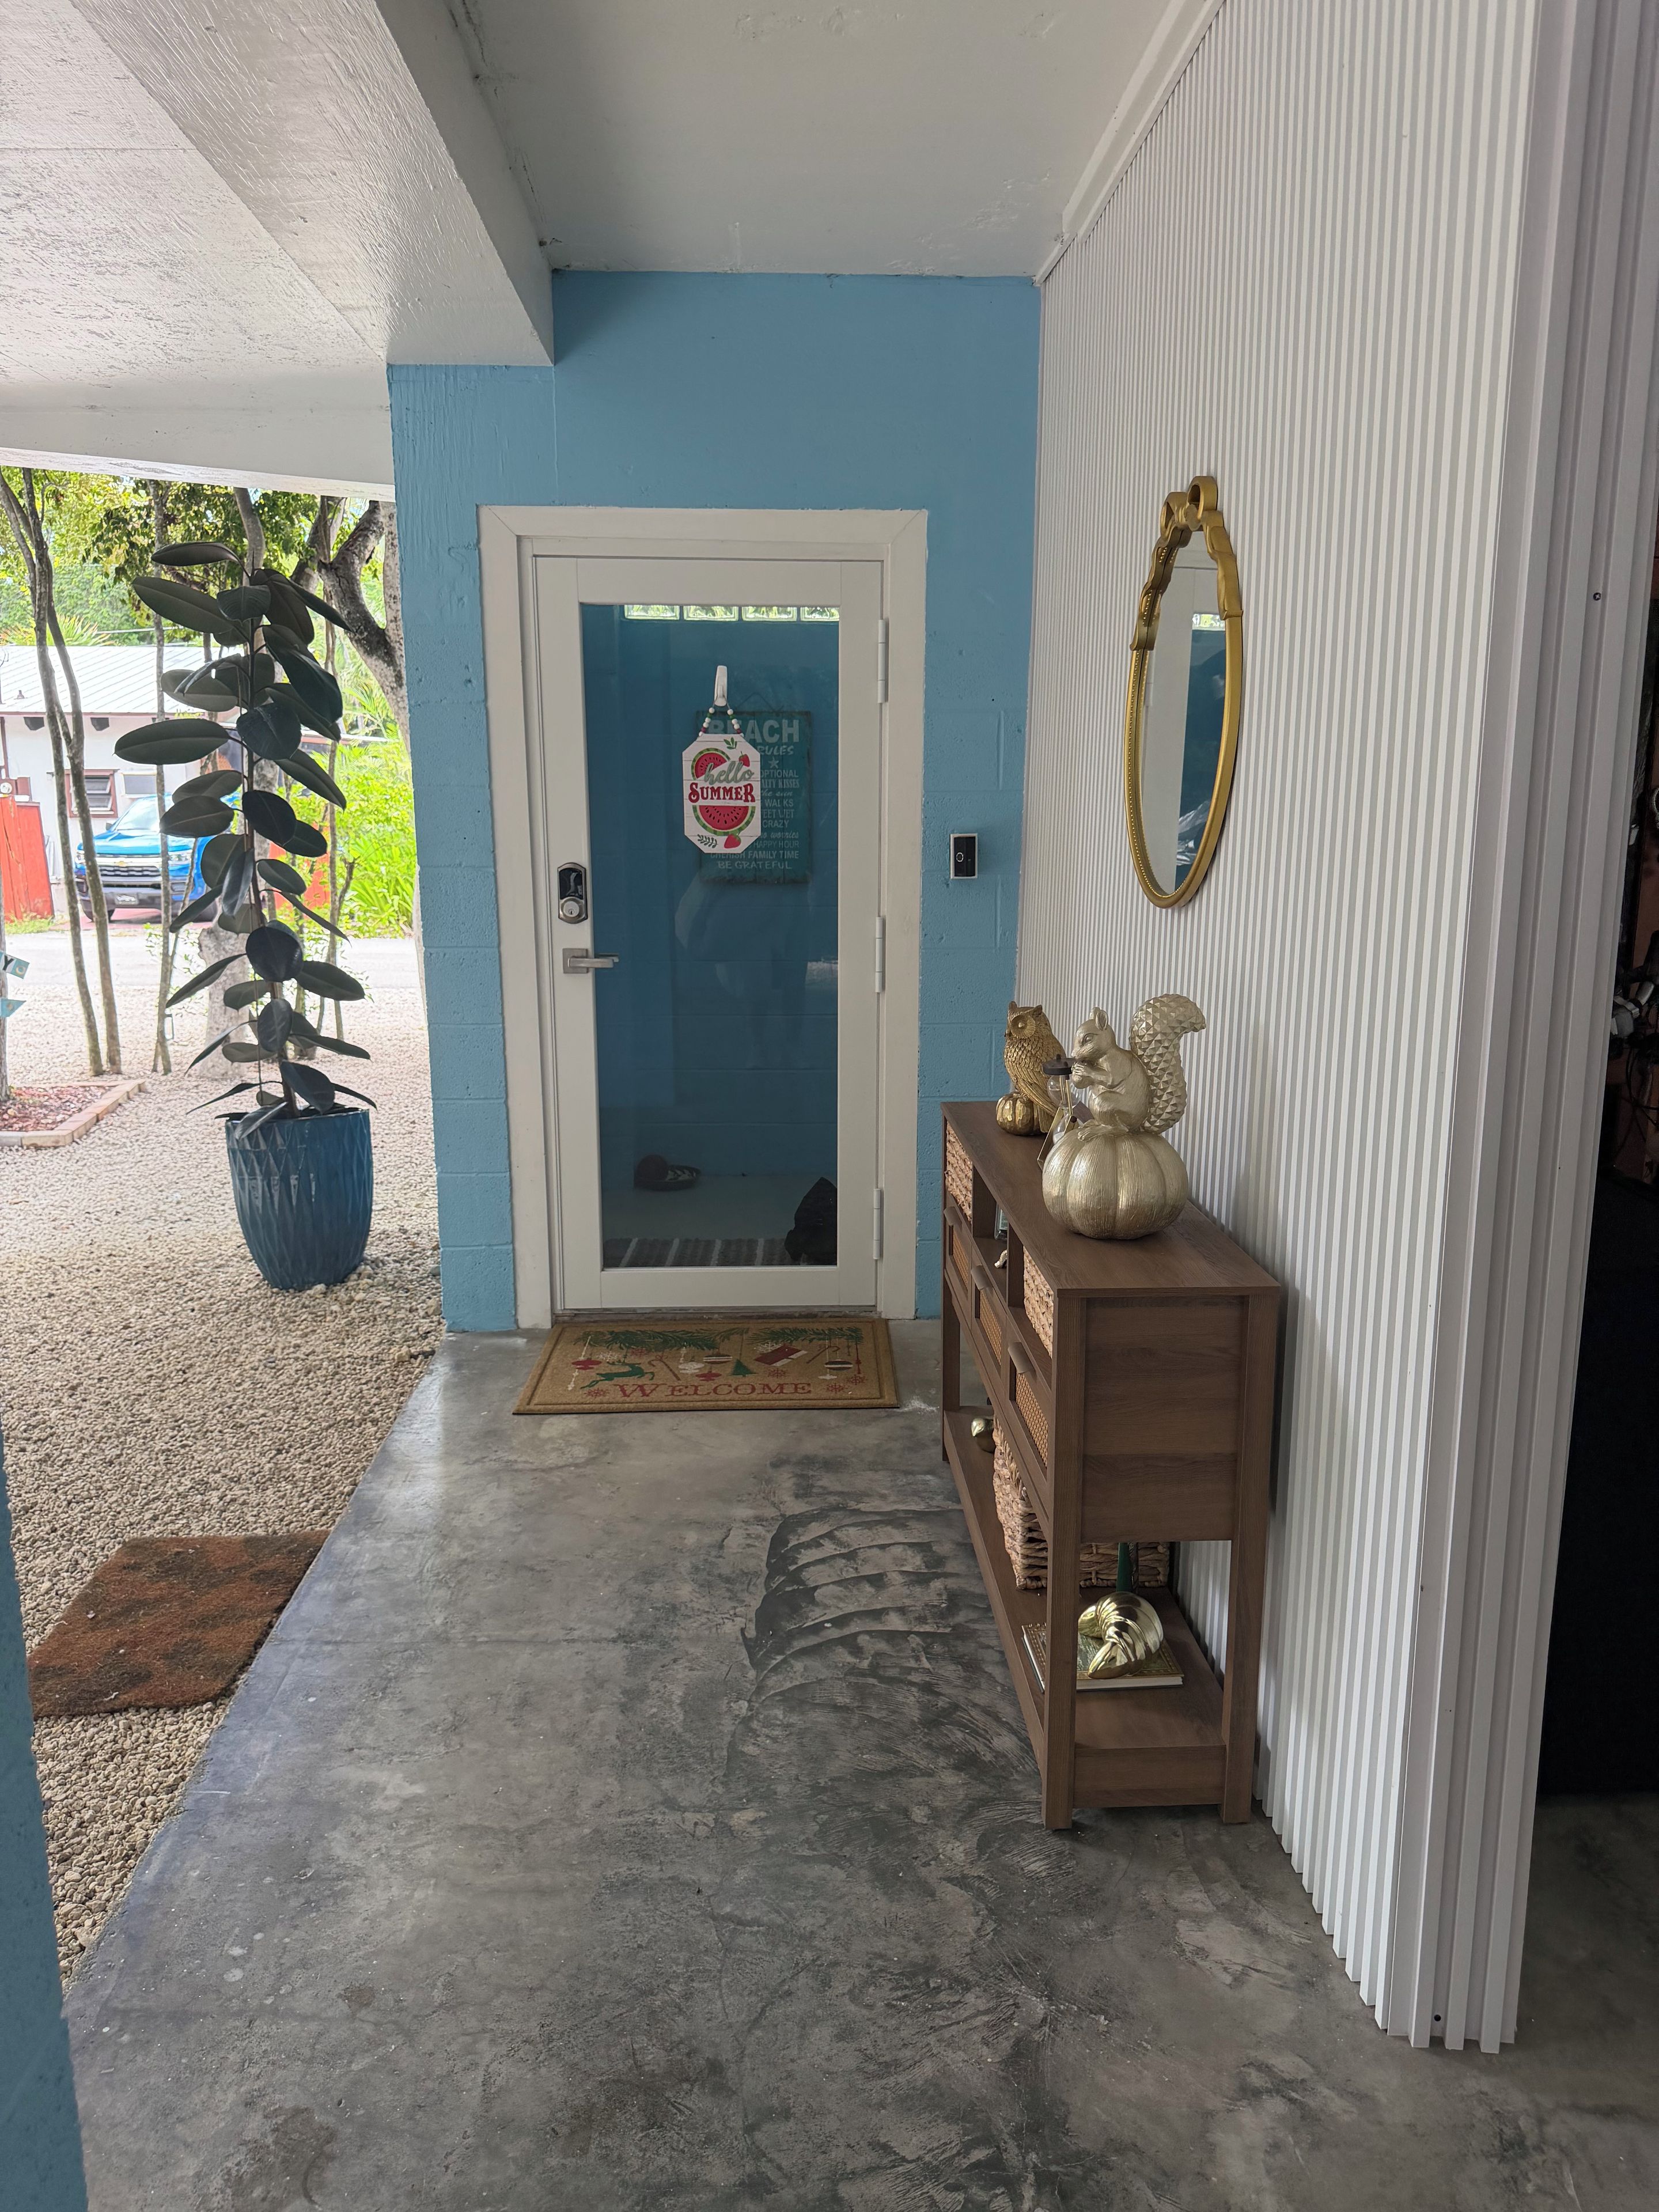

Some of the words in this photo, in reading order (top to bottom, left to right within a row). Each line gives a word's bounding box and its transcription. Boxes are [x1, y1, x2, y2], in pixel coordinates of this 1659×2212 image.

[703, 760, 755, 785] hello
[778, 779, 800, 789] KISSES
[688, 782, 756, 804] SUMMER
[764, 798, 794, 807] WALKS
[762, 819, 789, 828] CRAZY
[753, 840, 777, 849] HAPPY
[778, 840, 800, 849] HOUR
[748, 850, 777, 859] FAMILY
[779, 850, 800, 859] TIME
[717, 861, 732, 869] BE
[734, 861, 793, 869] GRATEFUL
[612, 1382, 812, 1398] WELCOME
